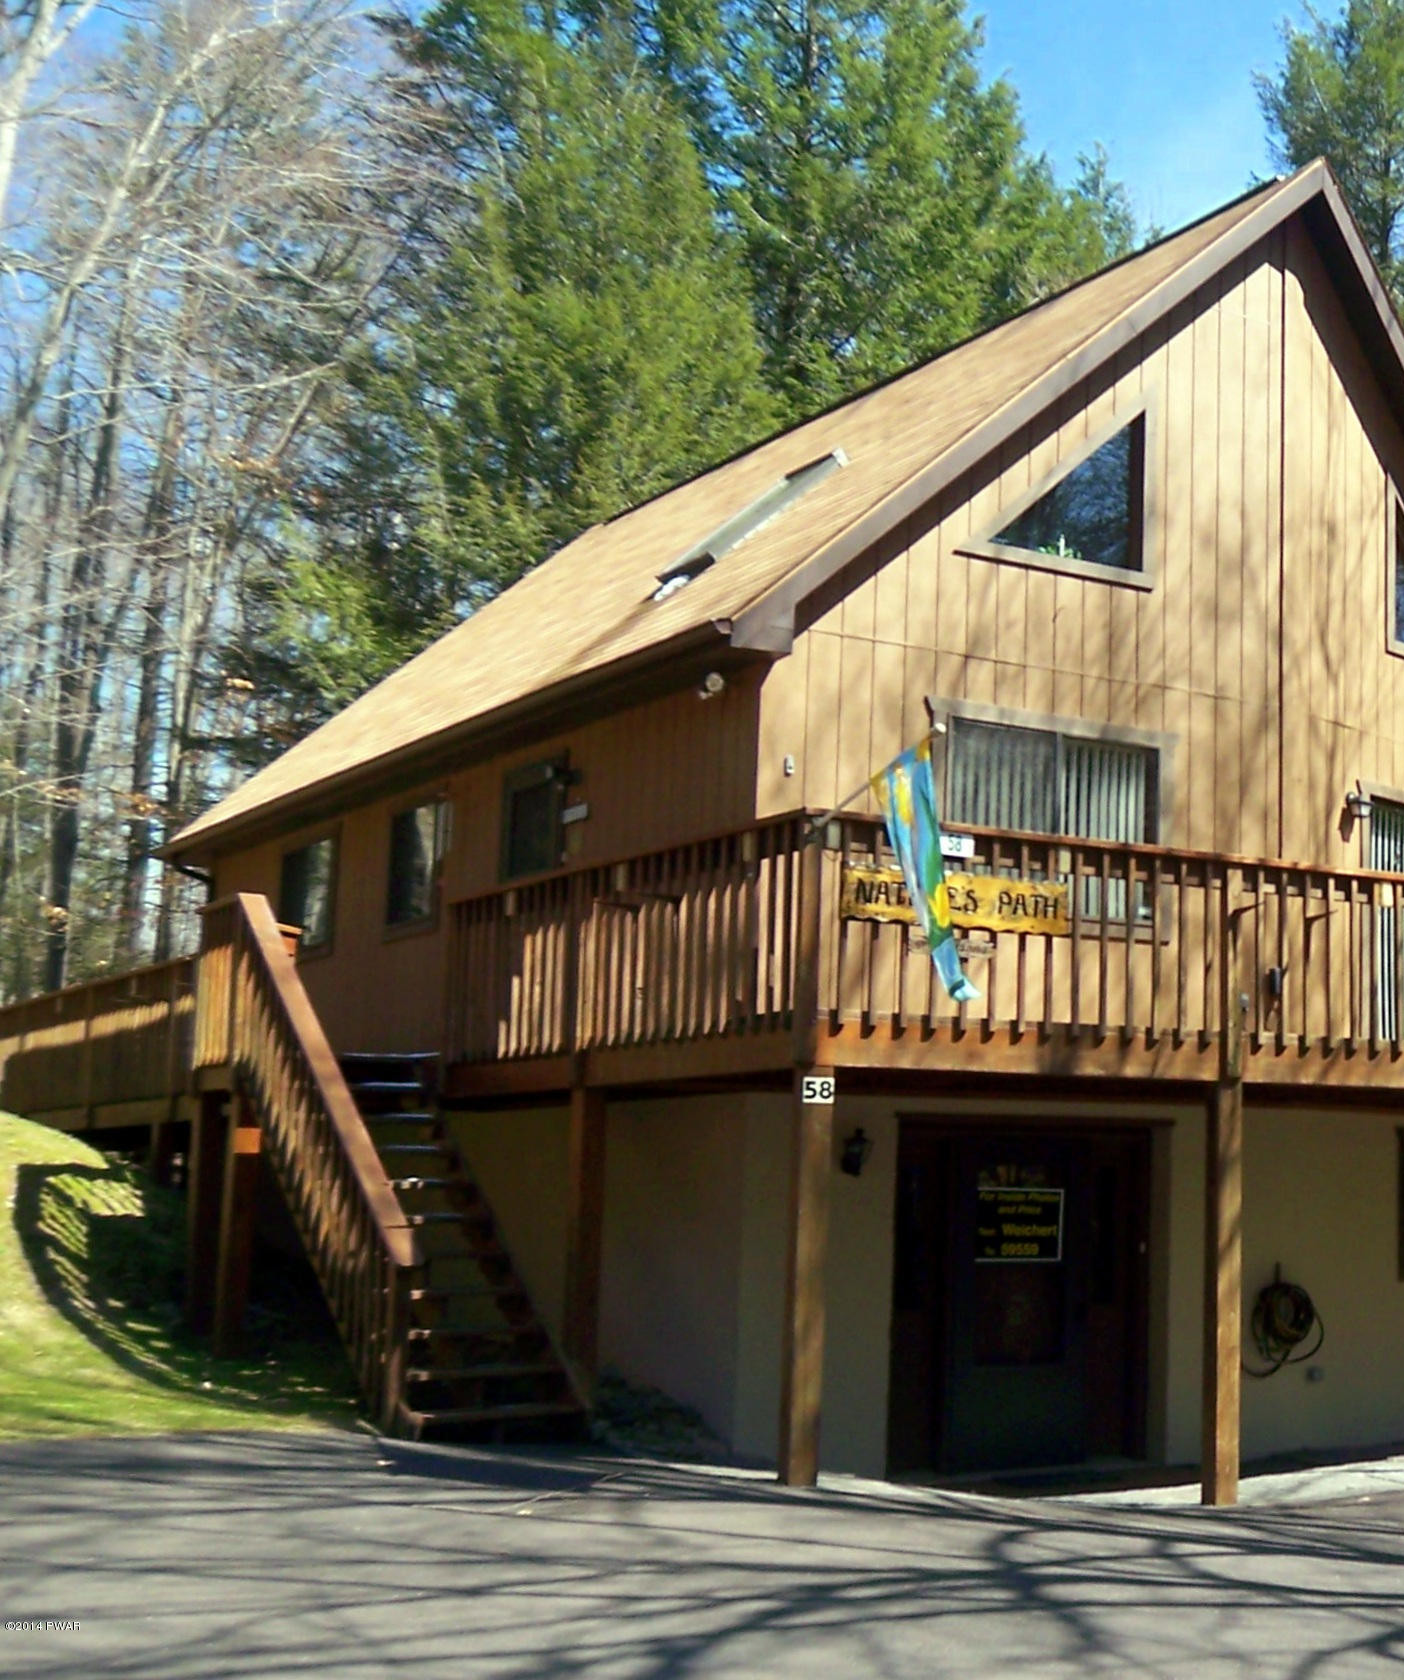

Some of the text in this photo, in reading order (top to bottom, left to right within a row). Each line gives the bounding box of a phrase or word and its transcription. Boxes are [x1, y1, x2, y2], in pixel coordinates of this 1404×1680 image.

[855, 878, 1058, 920] NATE'S PATH
[804, 1080, 832, 1100] 58
[1001, 1223, 1058, 1237] Weichert
